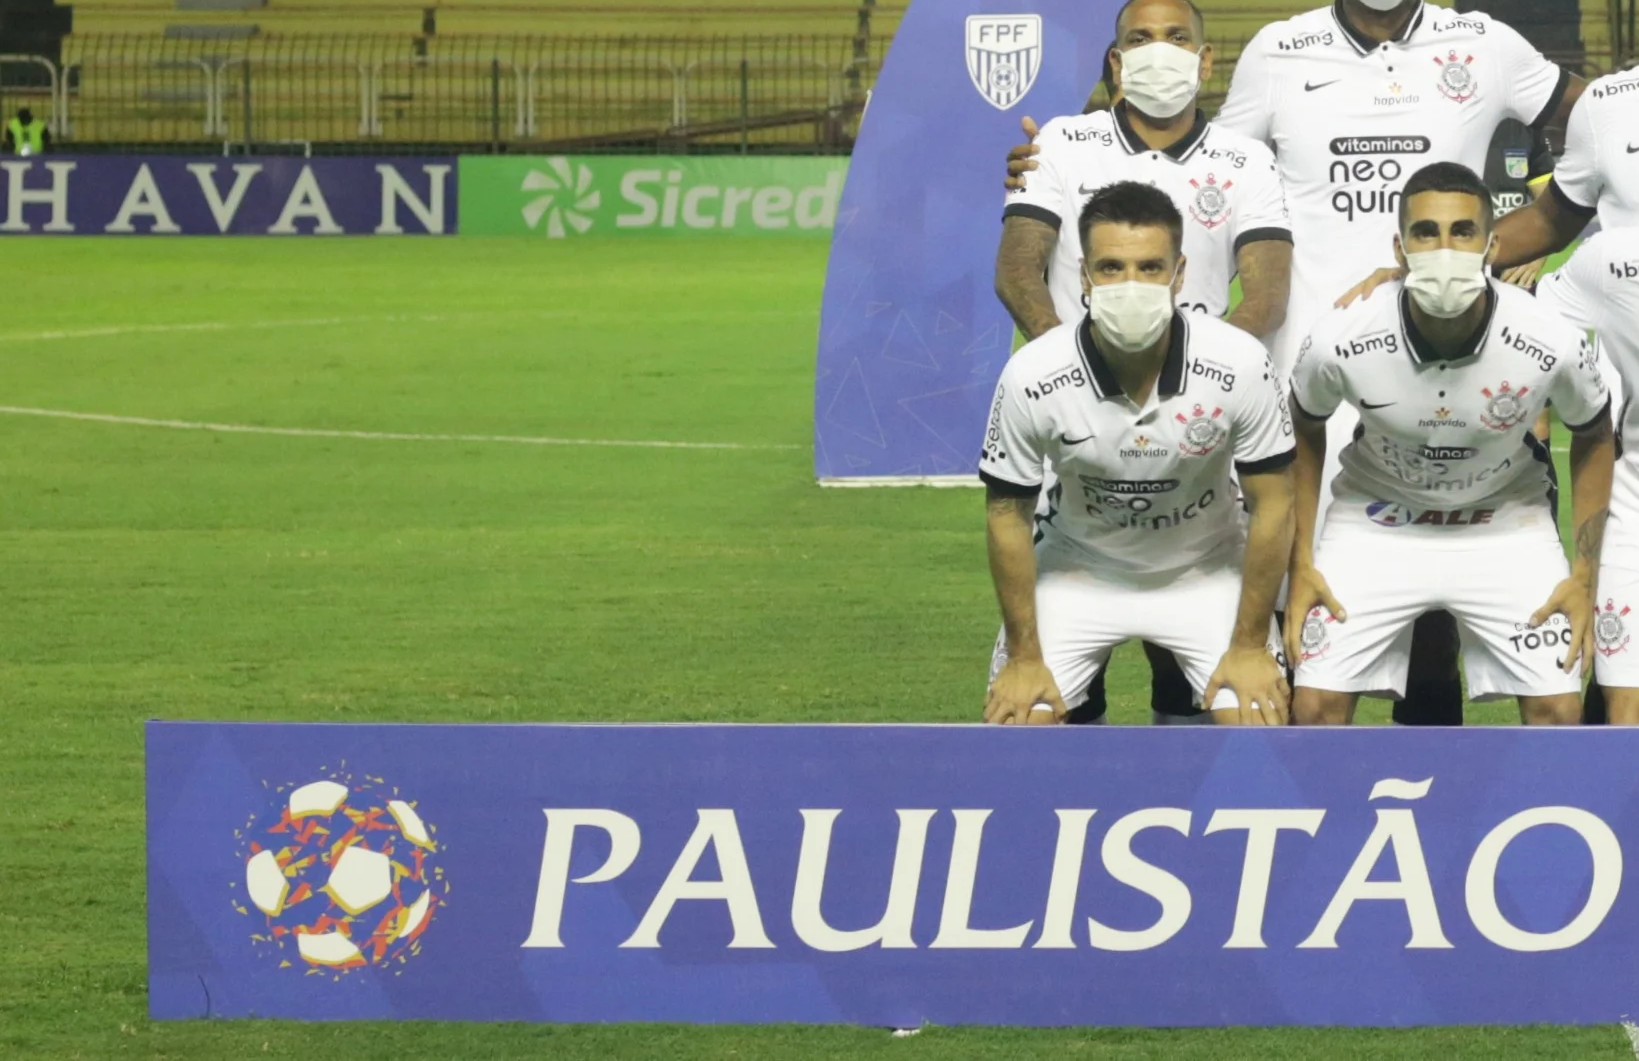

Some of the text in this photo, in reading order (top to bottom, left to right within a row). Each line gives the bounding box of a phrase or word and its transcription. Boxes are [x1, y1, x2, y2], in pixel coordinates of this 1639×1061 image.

[979, 24, 1028, 43] FPF
[1292, 30, 1333, 50] bmg
[1374, 94, 1420, 106] hapvida
[1076, 128, 1113, 146] bmg
[1336, 139, 1424, 152] vitaminas
[1330, 158, 1401, 183] neo
[0, 161, 451, 234] HAVAN
[1351, 333, 1398, 356] bmg
[1512, 332, 1557, 372] bmg
[1039, 366, 1085, 397] bmg
[1191, 357, 1236, 392] bmg
[1418, 417, 1467, 428] hapvida
[1119, 447, 1169, 458] hapvida
[1413, 508, 1497, 526] ALE
[520, 776, 1623, 953] PAULISTÃO
